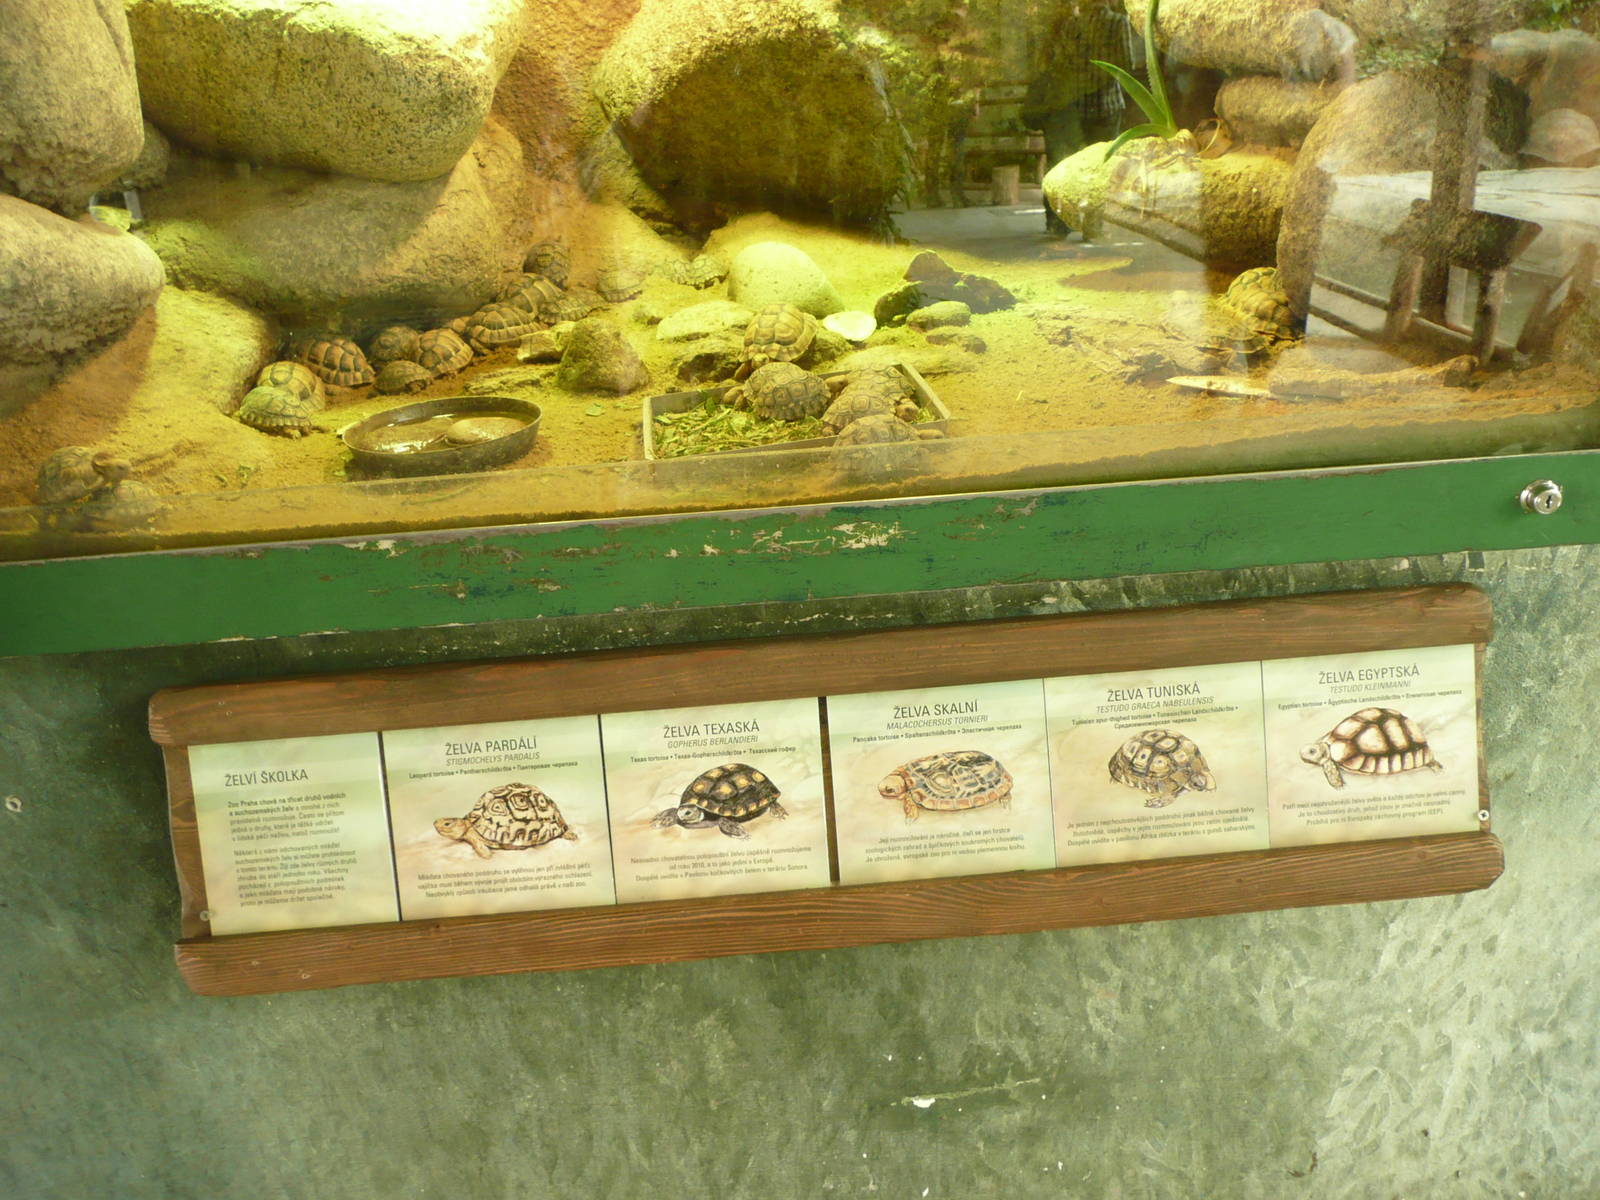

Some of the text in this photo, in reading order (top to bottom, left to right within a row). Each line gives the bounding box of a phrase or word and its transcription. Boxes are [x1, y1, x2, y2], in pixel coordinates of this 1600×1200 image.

[1319, 663, 1420, 684] ŽELVA EGYPTSKÁ
[1107, 681, 1200, 702] ŽELVA TUNISKÁ
[1330, 681, 1411, 694] TESTUDO KLEINMANNI
[894, 699, 978, 719] ŽELVA SKALNÍ
[1097, 696, 1214, 714] TESTUDO GRAECA NABEULENSIS
[664, 719, 759, 738] ŽELVA TEXASKÁ
[887, 715, 988, 730] MALACOCHERSUS TORNIERI
[445, 736, 536, 756] ŽELVA PARDÁLÍ
[668, 736, 758, 749] GOPHERUS BERLANDIERI
[446, 752, 540, 767] STIGMOCHELYS PARDALIS
[225, 769, 308, 786] ŽELVÍ ŠKOLKA
